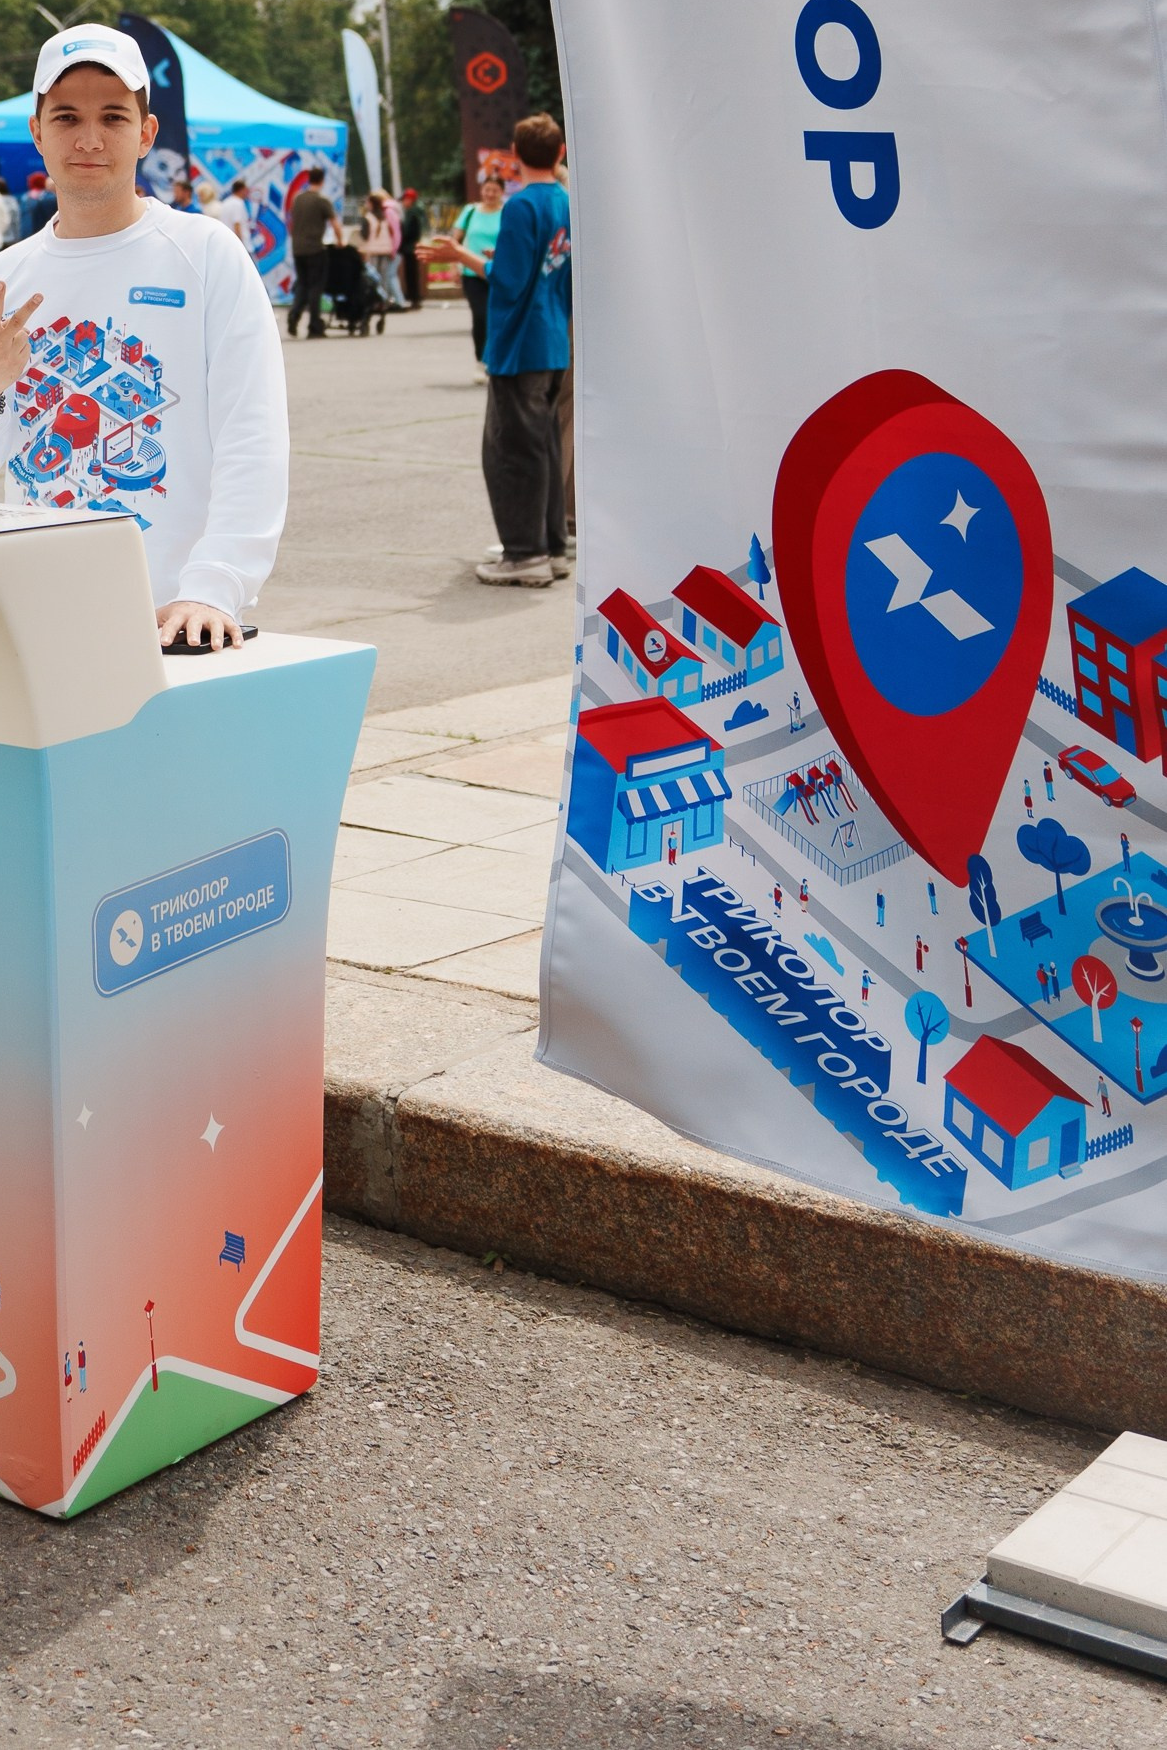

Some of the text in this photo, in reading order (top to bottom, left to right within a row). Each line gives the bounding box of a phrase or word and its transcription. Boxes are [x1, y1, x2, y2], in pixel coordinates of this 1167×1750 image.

[150, 876, 229, 923] ТРИКОЛОР
[151, 884, 275, 953] В ТВОЕМ ГОРОДЕ
[684, 866, 892, 1053] ТРИКОЛОР
[633, 880, 968, 1178] В ТВОЕМ ГОРОДЕ
